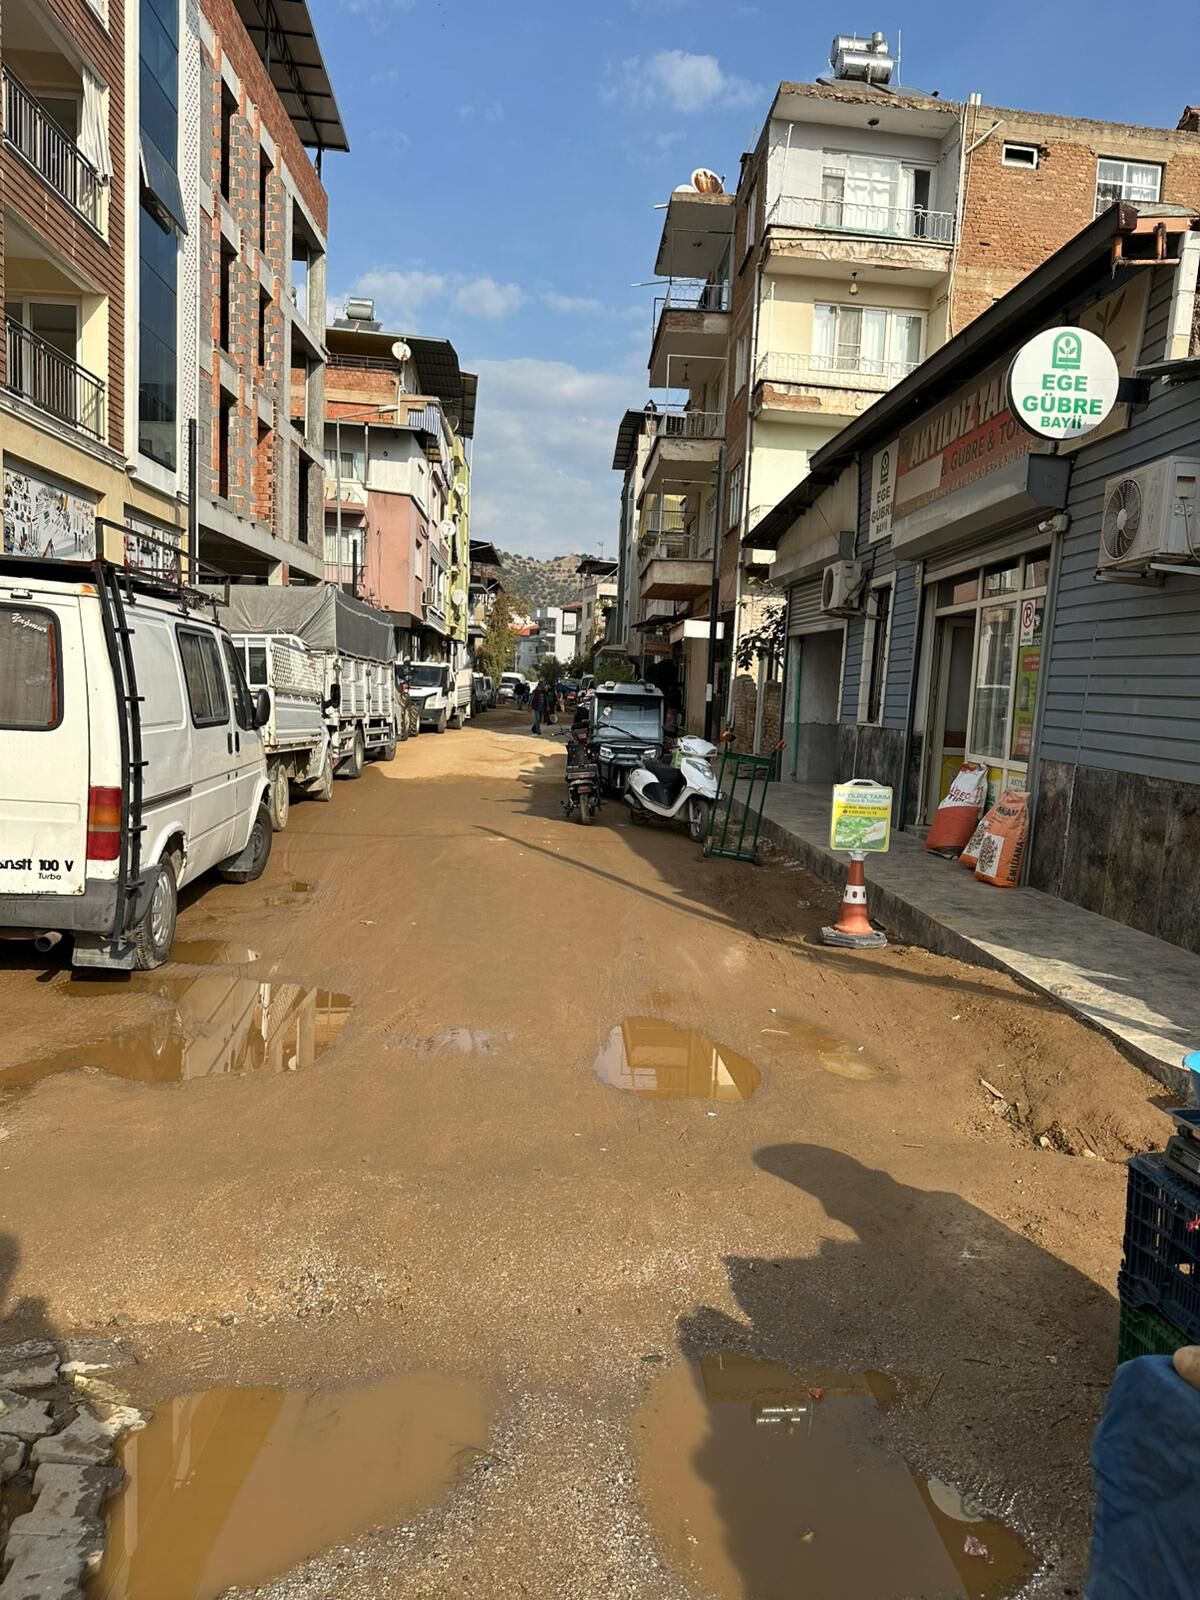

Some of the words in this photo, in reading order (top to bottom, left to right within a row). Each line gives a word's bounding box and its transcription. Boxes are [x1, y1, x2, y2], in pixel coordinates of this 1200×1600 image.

[1041, 373, 1088, 392] EGE
[1022, 393, 1103, 416] GÜBRE
[908, 392, 977, 469] AKYILDIZ
[876, 485, 891, 504] EGE
[39, 859, 59, 872] 100
[65, 860, 74, 872] V
[38, 872, 62, 880] Turbo
